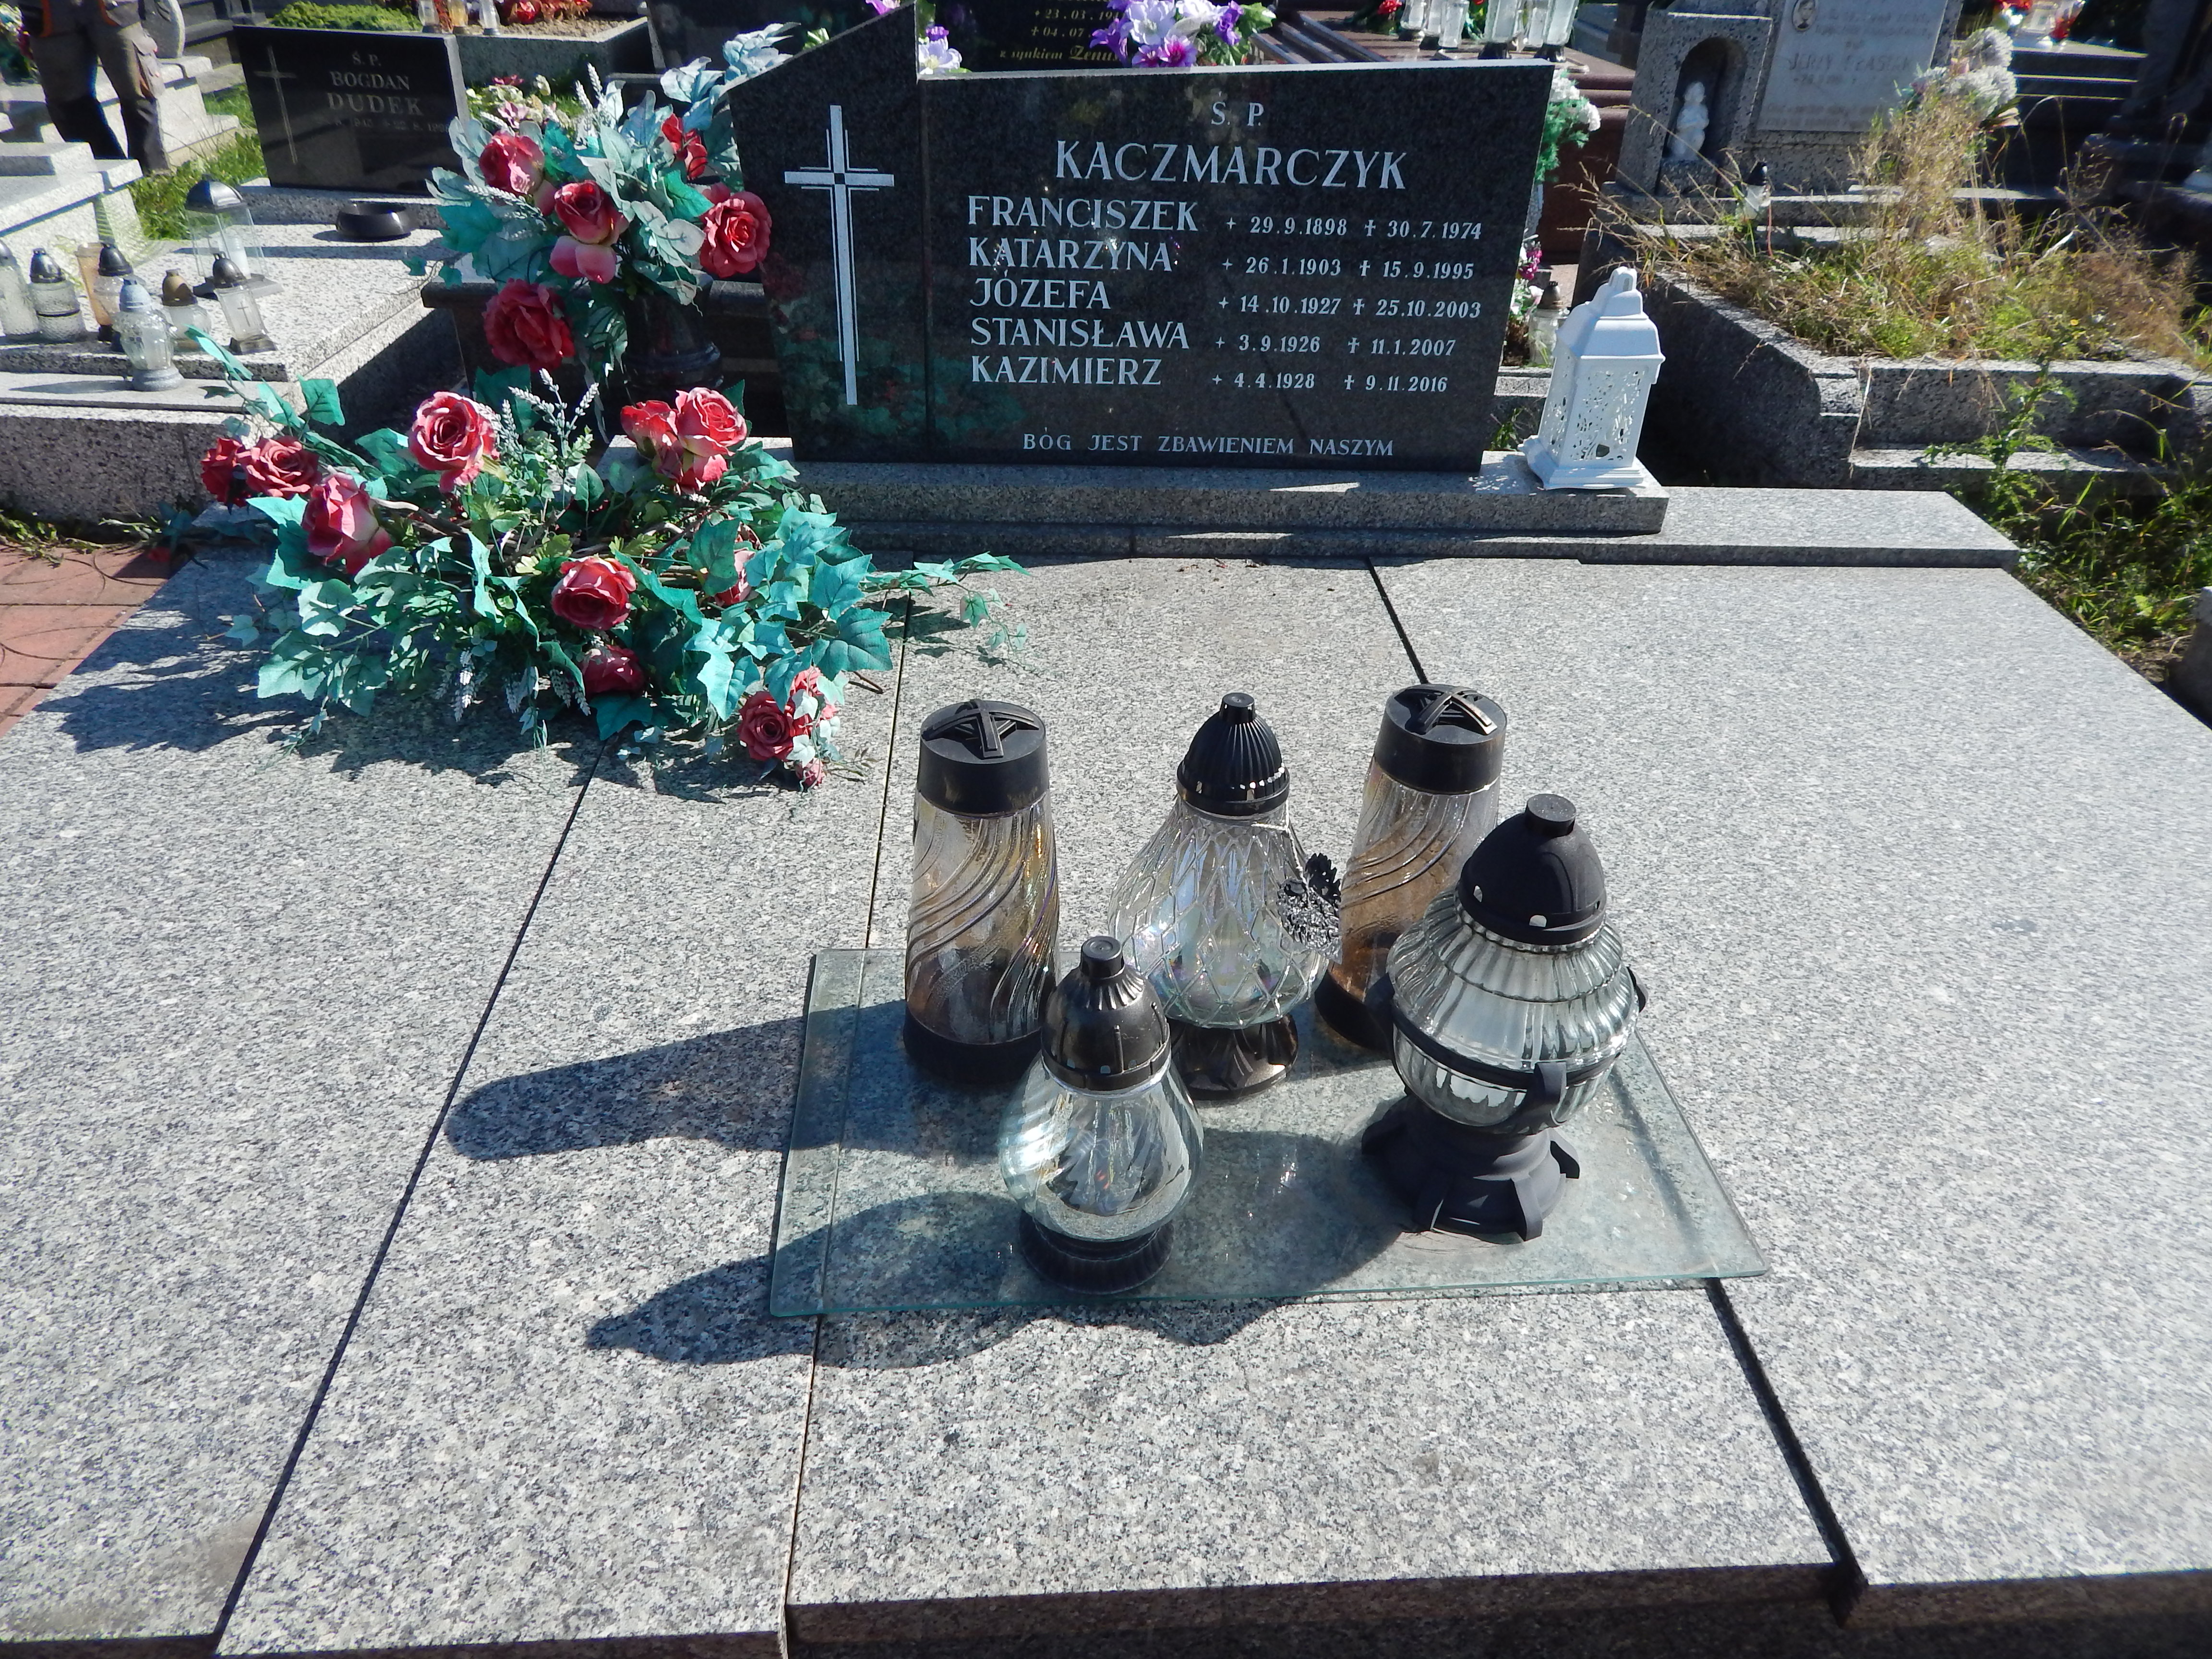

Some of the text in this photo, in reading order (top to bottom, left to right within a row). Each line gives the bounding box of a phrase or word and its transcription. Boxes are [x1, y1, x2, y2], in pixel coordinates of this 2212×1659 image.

[1010, 48, 1063, 61] synkiem
[329, 71, 410, 90] BOGDAN
[326, 92, 424, 116] DUDEK
[1056, 140, 1407, 189] KACZMARCZYK
[968, 195, 1481, 239] FRANCISZEK 29.9.1898 30.7.1974
[969, 237, 1474, 279] KATARZYNA 26.1.1903 15.9.1995
[970, 269, 1481, 318] JÓZEFA 14.10.1927 25.10.2003
[971, 317, 1456, 356] STANISŁAWA 3.9.1926 11.1.2007
[972, 356, 1448, 393] KAZIMIERZ 4.4.1928 9.11.2016
[1023, 427, 1393, 456] BÓG JEST ZBAWIENIEM NASZYM
